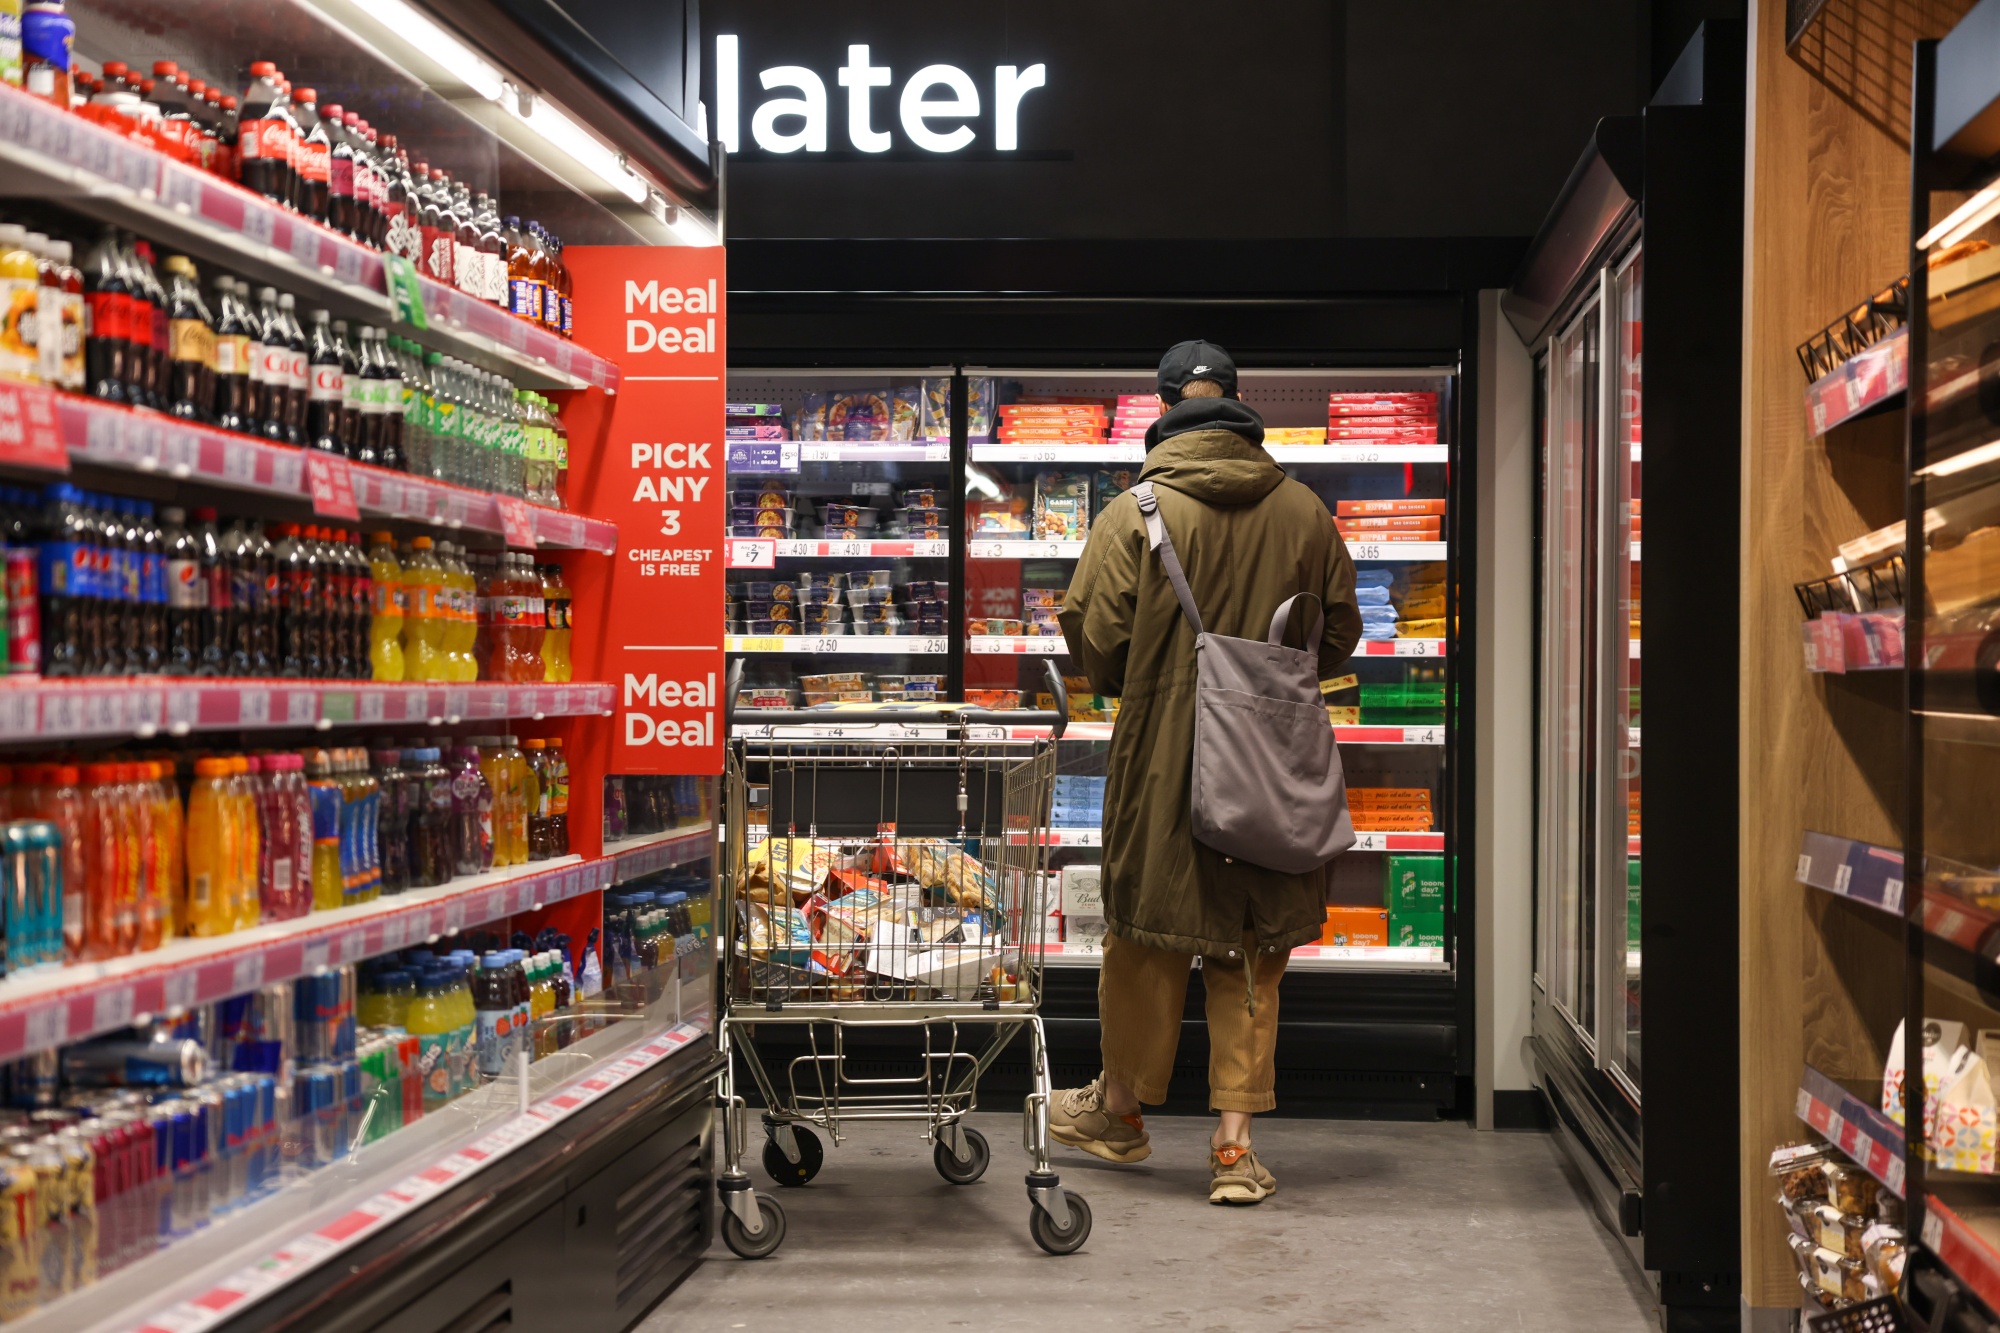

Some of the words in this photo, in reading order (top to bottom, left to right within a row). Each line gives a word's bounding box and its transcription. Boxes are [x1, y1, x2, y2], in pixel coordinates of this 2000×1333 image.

[716, 34, 1046, 154] later
[625, 278, 717, 314] Meal
[626, 318, 716, 353] Deal
[631, 442, 712, 469] PICK
[632, 476, 709, 502] ANY
[660, 509, 681, 536] 3
[628, 549, 713, 562] CHEAPEST
[988, 544, 1003, 557] £3
[1043, 544, 1058, 557] £3
[746, 552, 759, 563] £7
[641, 564, 656, 576] IS
[660, 564, 701, 576] FREE
[989, 640, 1001, 652] £3
[1043, 640, 1056, 652] £3
[1413, 642, 1425, 655] £3
[624, 672, 716, 707] Meal
[1041, 697, 1056, 706] EAT
[625, 711, 714, 746] Deal
[755, 725, 770, 738] £4
[827, 726, 843, 738] £4
[904, 726, 920, 738] £4
[987, 728, 999, 738] £4
[1421, 730, 1434, 743] £4
[1077, 834, 1089, 845] £4
[1360, 836, 1373, 849] £4
[1075, 893, 1101, 904] Bud
[1352, 939, 1371, 947] day?
[1222, 1150, 1236, 1158] Y-3
